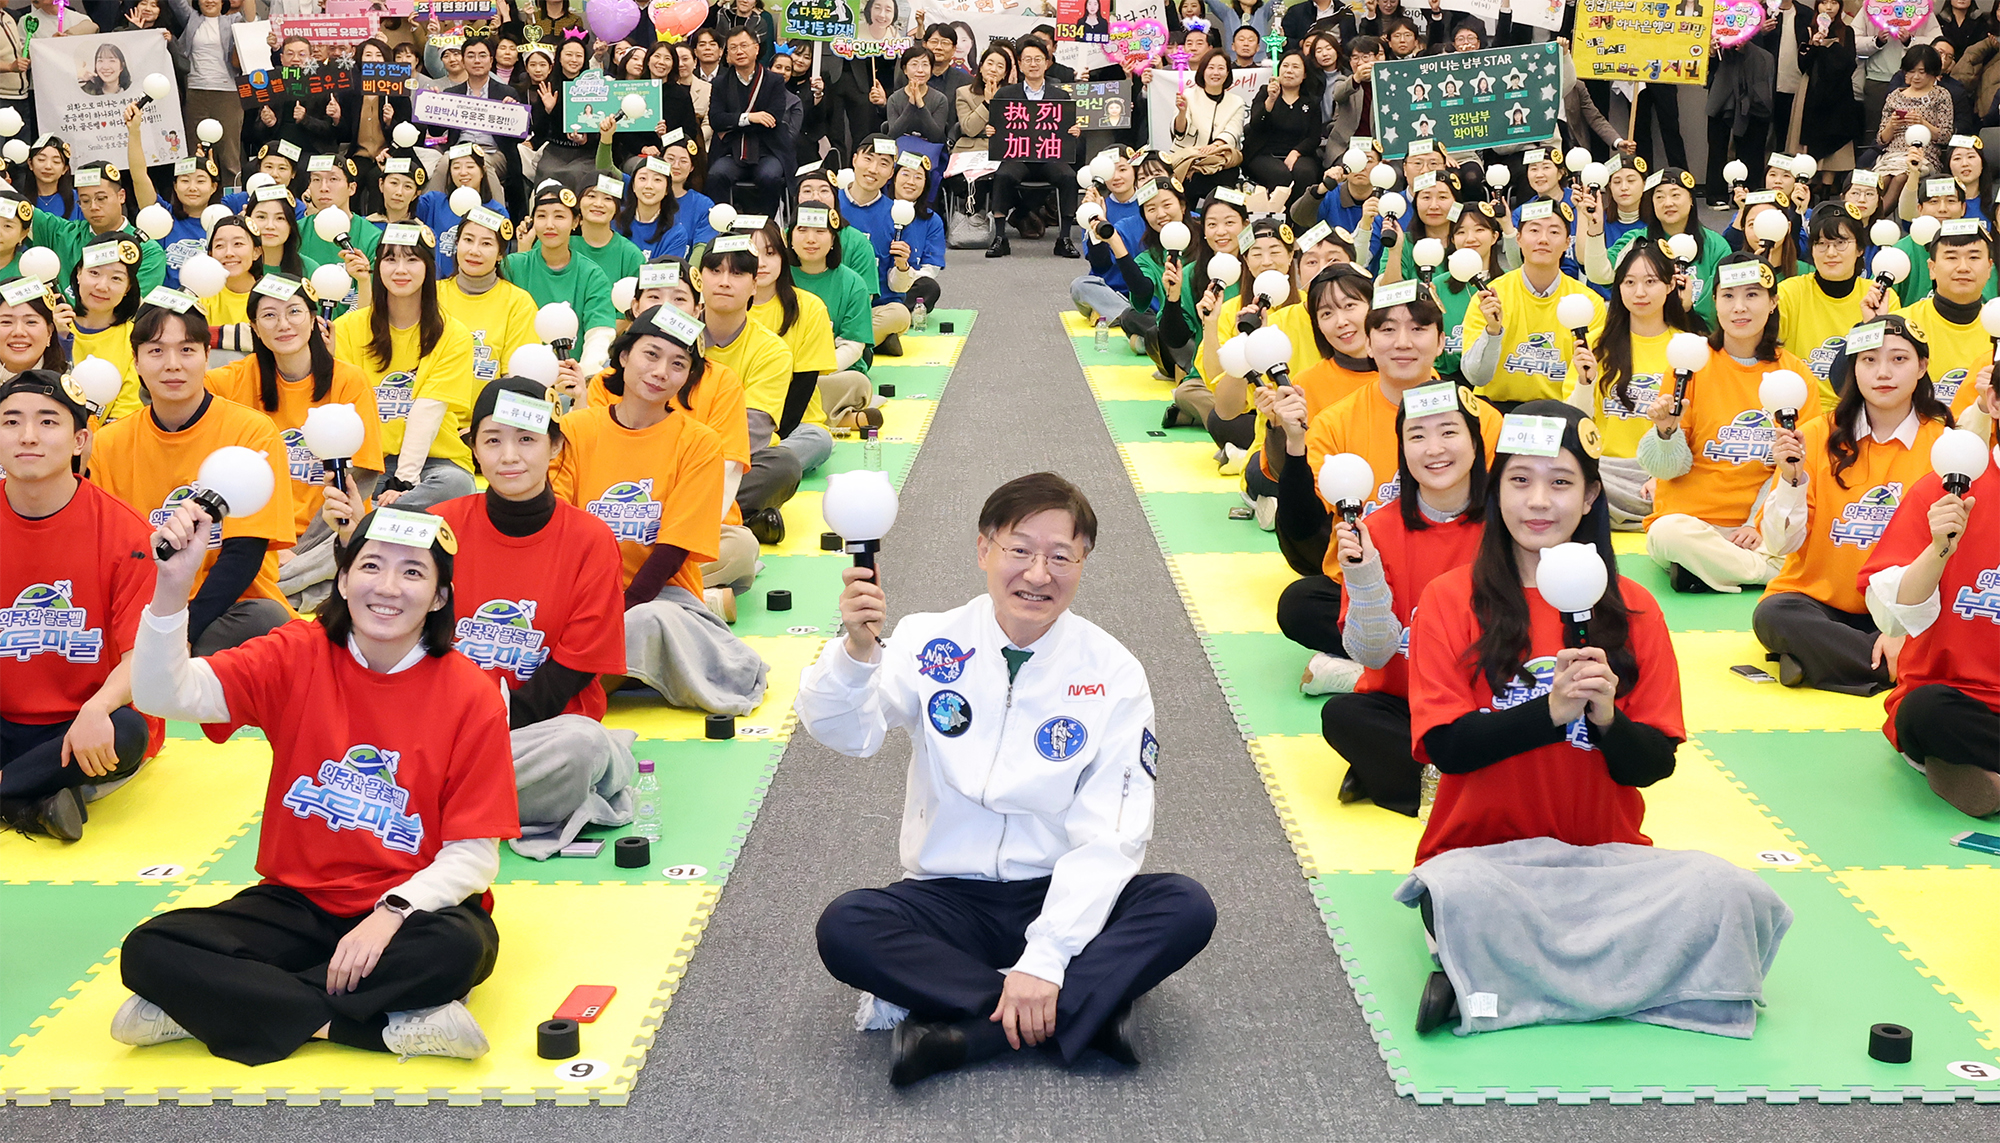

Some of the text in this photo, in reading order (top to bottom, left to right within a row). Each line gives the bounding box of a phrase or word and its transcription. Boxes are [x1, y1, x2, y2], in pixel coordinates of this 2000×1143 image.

[799, 7, 811, 17] 다
[1640, 2, 1670, 18] 자랑
[315, 27, 338, 37] 1등은
[340, 27, 368, 36] 유윤주
[788, 19, 809, 35] 그냥
[1057, 24, 1084, 38] 1534
[1616, 19, 1675, 34] 하나은행의
[362, 63, 412, 77] 삼성전자
[1419, 54, 1513, 74] 빛이 나는 남부 STAR
[1643, 59, 1700, 80] 정지민
[309, 71, 350, 94] 금유은
[362, 79, 403, 95] 삐약이
[1076, 98, 1103, 109] 여신
[424, 105, 511, 126] 외환박사 유윤주 등장!!
[1003, 101, 1063, 131] 热烈
[1449, 110, 1491, 126] 갑진남부
[1453, 125, 1488, 140] 화이팅!
[1003, 133, 1062, 159] 加油
[107, 165, 120, 179] 79
[1683, 172, 1695, 186] 73
[19, 203, 32, 218] 69
[502, 221, 513, 236] 57
[1907, 321, 1926, 339] 24
[1461, 390, 1479, 412] 15
[1721, 428, 1752, 441] 외국환
[1705, 441, 1777, 465] 부루마
[588, 502, 660, 518] 외국환 골든벨
[0, 609, 83, 628] 외국환 골든벨
[459, 622, 540, 649] 외국환 골든벨
[453, 641, 549, 678] 루마불
[925, 651, 960, 673] NASA
[1068, 684, 1105, 696] NASA
[321, 764, 405, 808] 외국환 골든벨
[287, 778, 422, 850] 부루마불
[1960, 1064, 1988, 1079] 5
